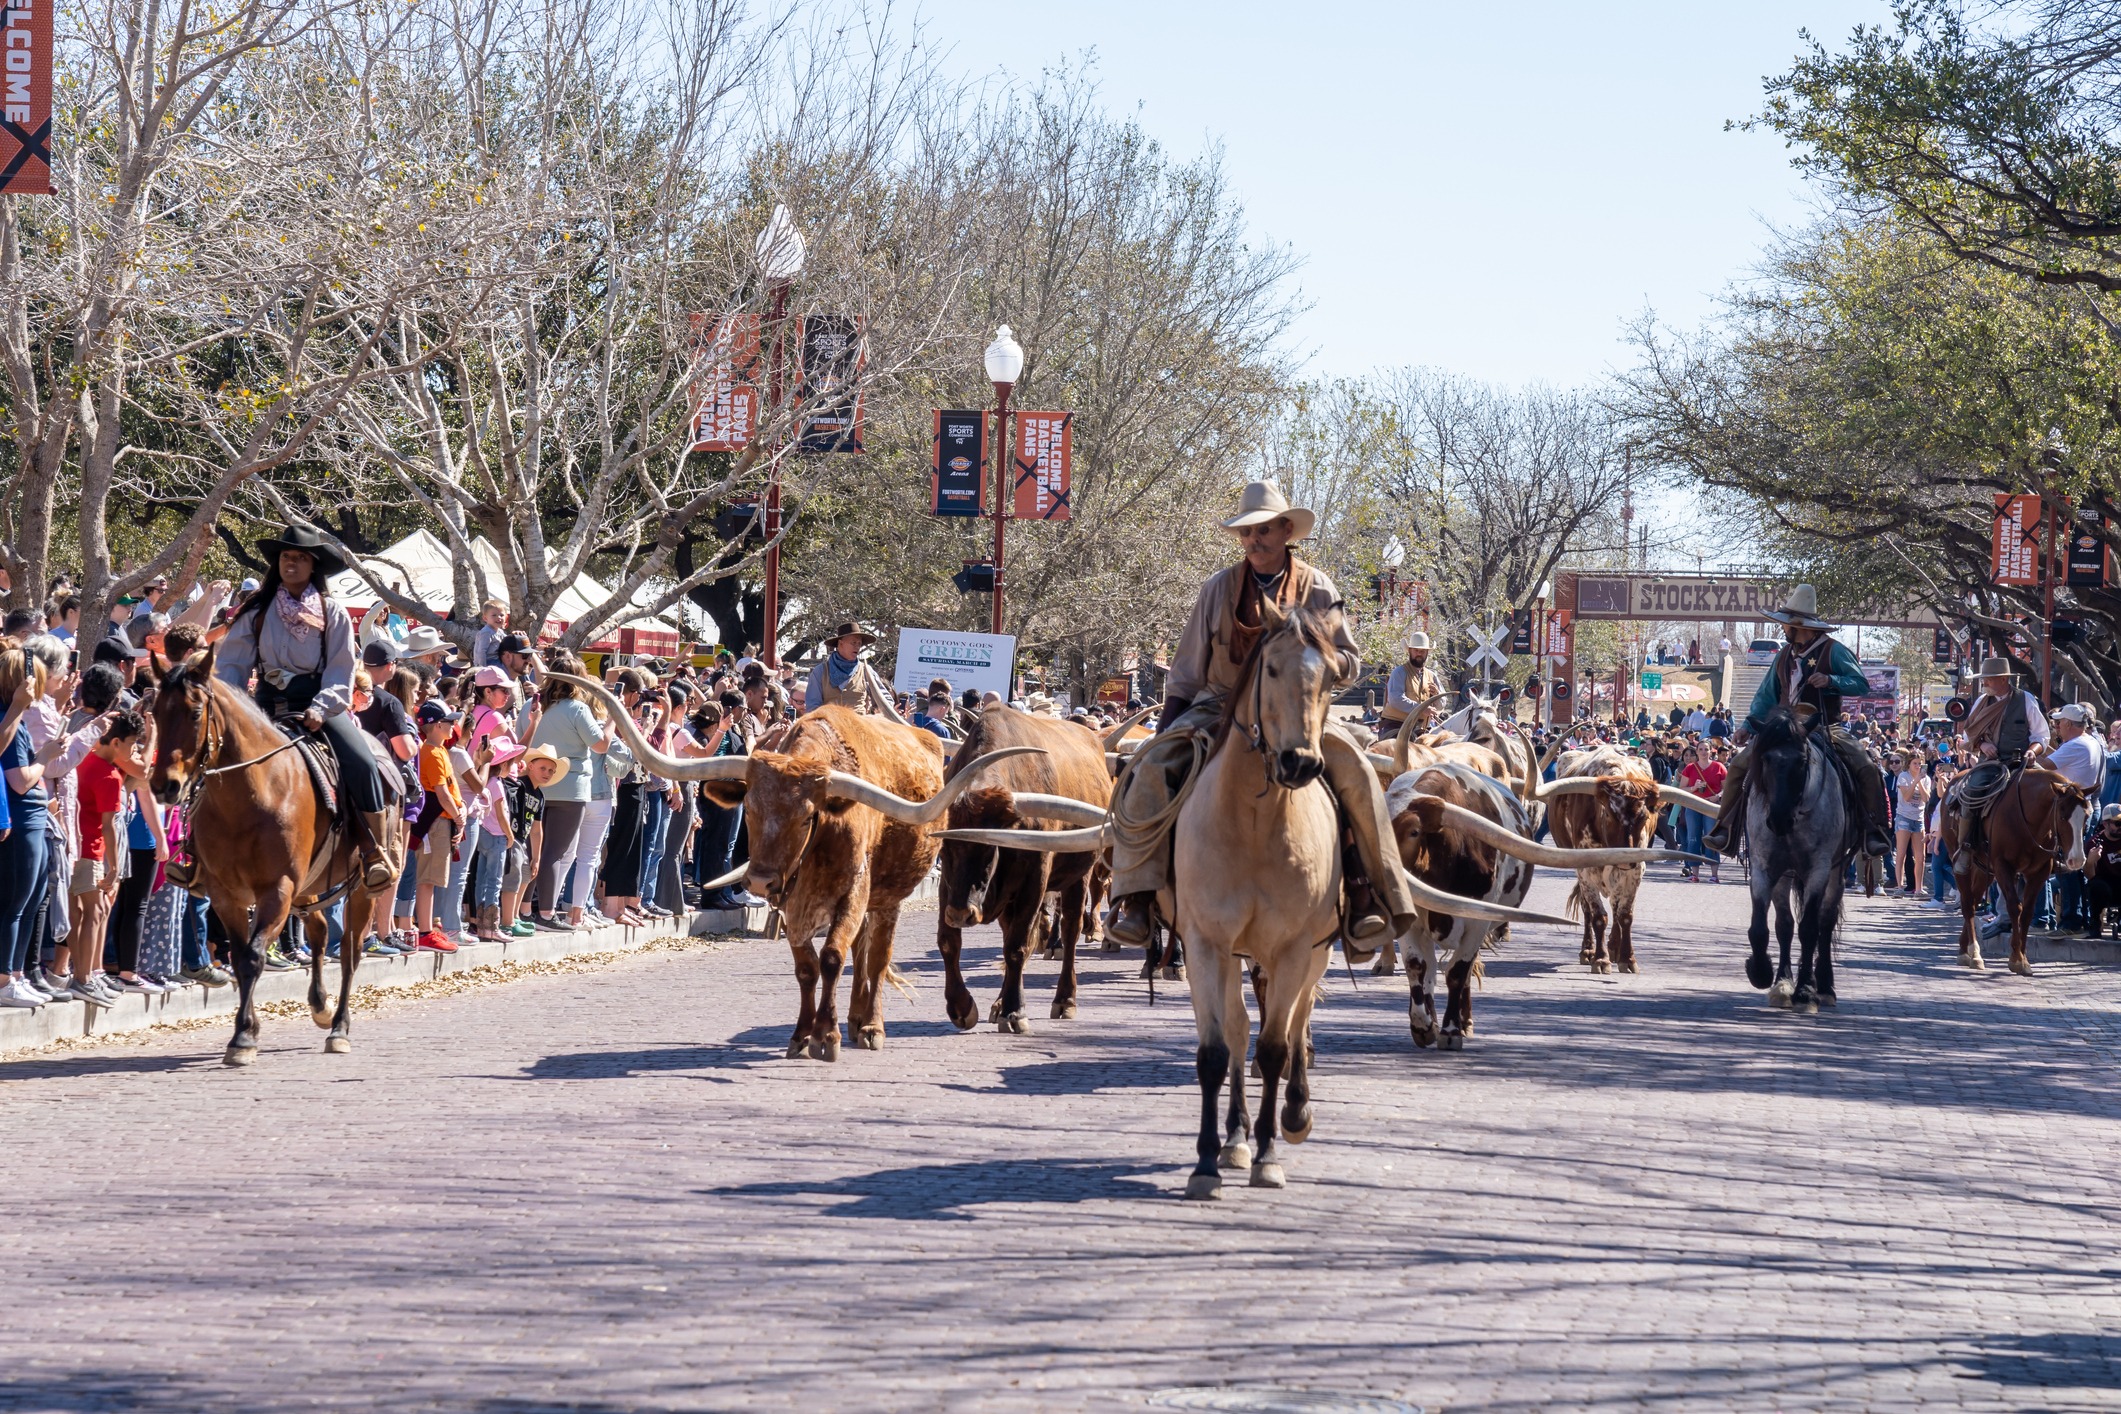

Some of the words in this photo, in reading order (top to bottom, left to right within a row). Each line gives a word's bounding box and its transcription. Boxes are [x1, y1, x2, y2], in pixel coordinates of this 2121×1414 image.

[732, 394, 749, 442] FANS
[1024, 419, 1037, 457] FANS
[1036, 419, 1050, 512] BASKETBALL
[1050, 419, 1063, 491] WELCOME
[1998, 518, 2012, 578] WELCOME
[2010, 500, 2023, 579] BASKETBALL
[2021, 547, 2032, 579] FANS
[1640, 584, 1789, 612] STOCKYARDS
[918, 644, 993, 660] GREEN
[920, 638, 967, 647] COWTOWN
